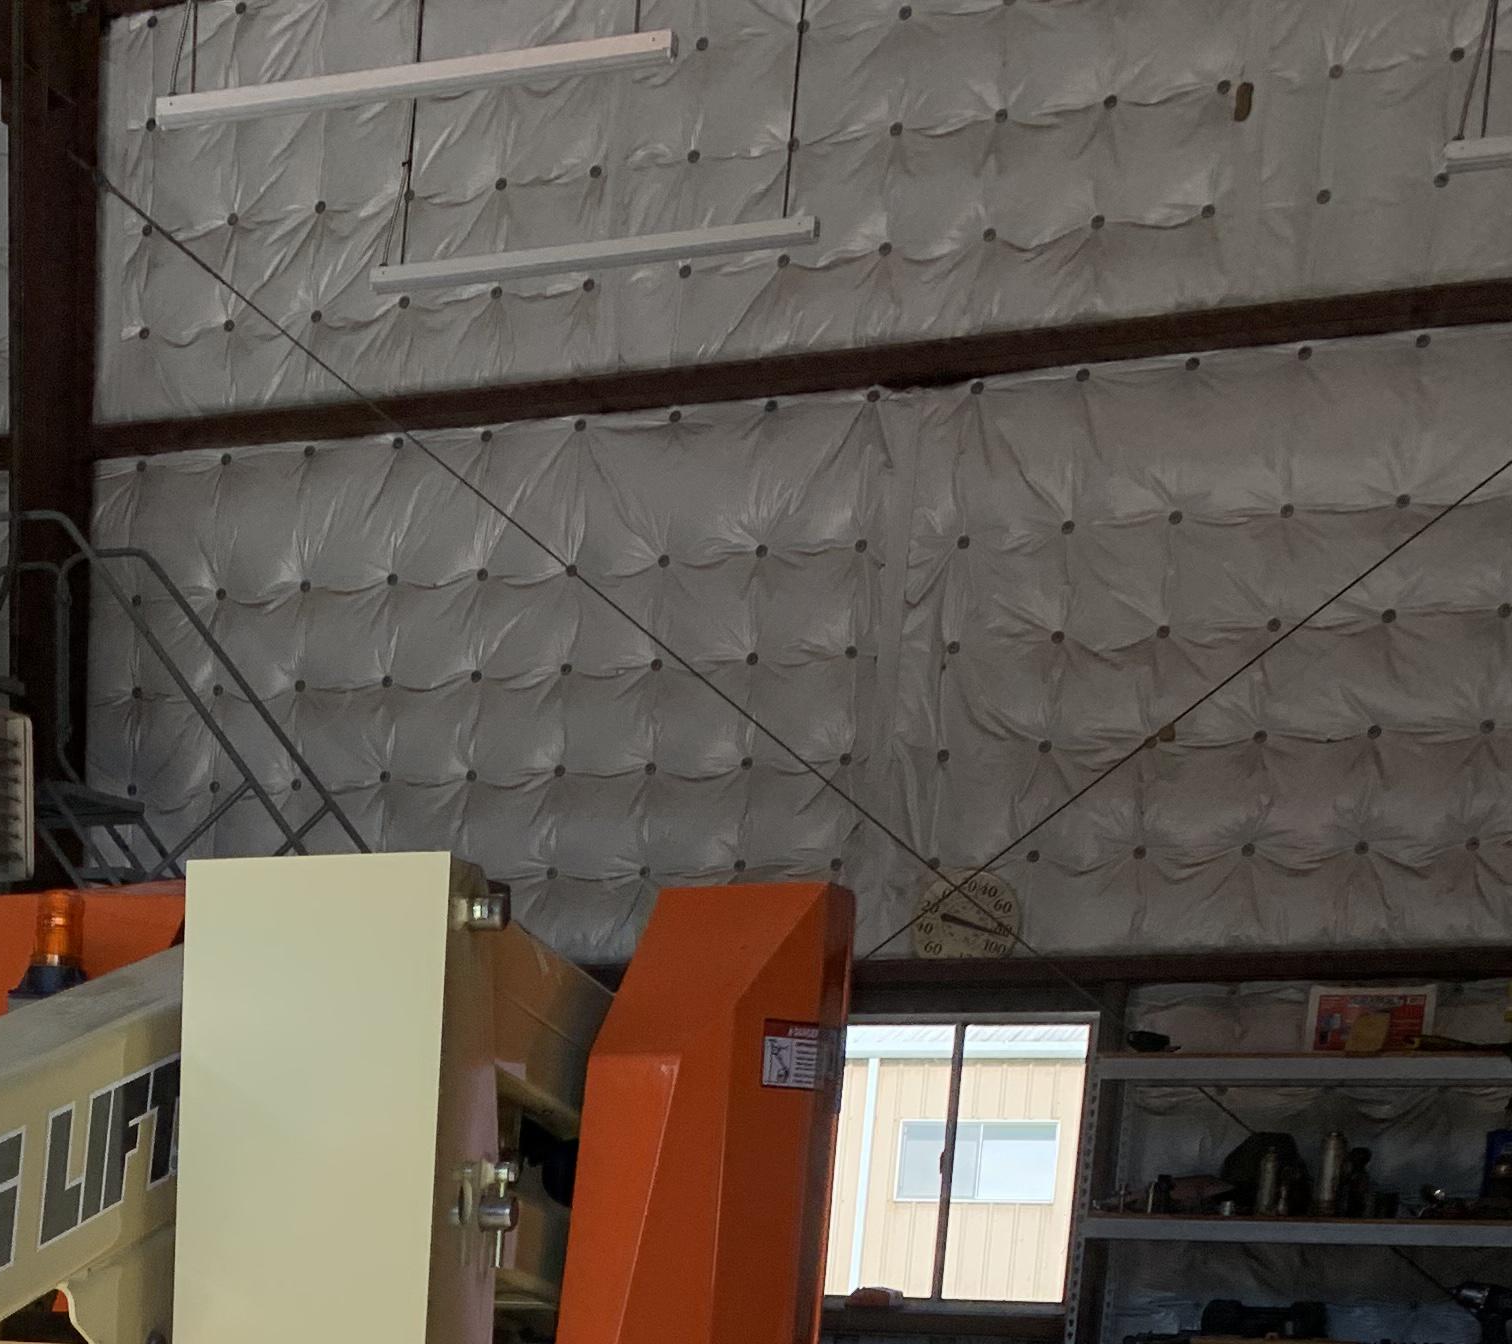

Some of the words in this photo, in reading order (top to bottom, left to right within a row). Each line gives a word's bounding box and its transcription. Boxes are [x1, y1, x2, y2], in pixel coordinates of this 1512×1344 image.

[994, 899, 1013, 914] 60
[924, 941, 942, 954] 60
[37, 1053, 180, 1251] LIFT
